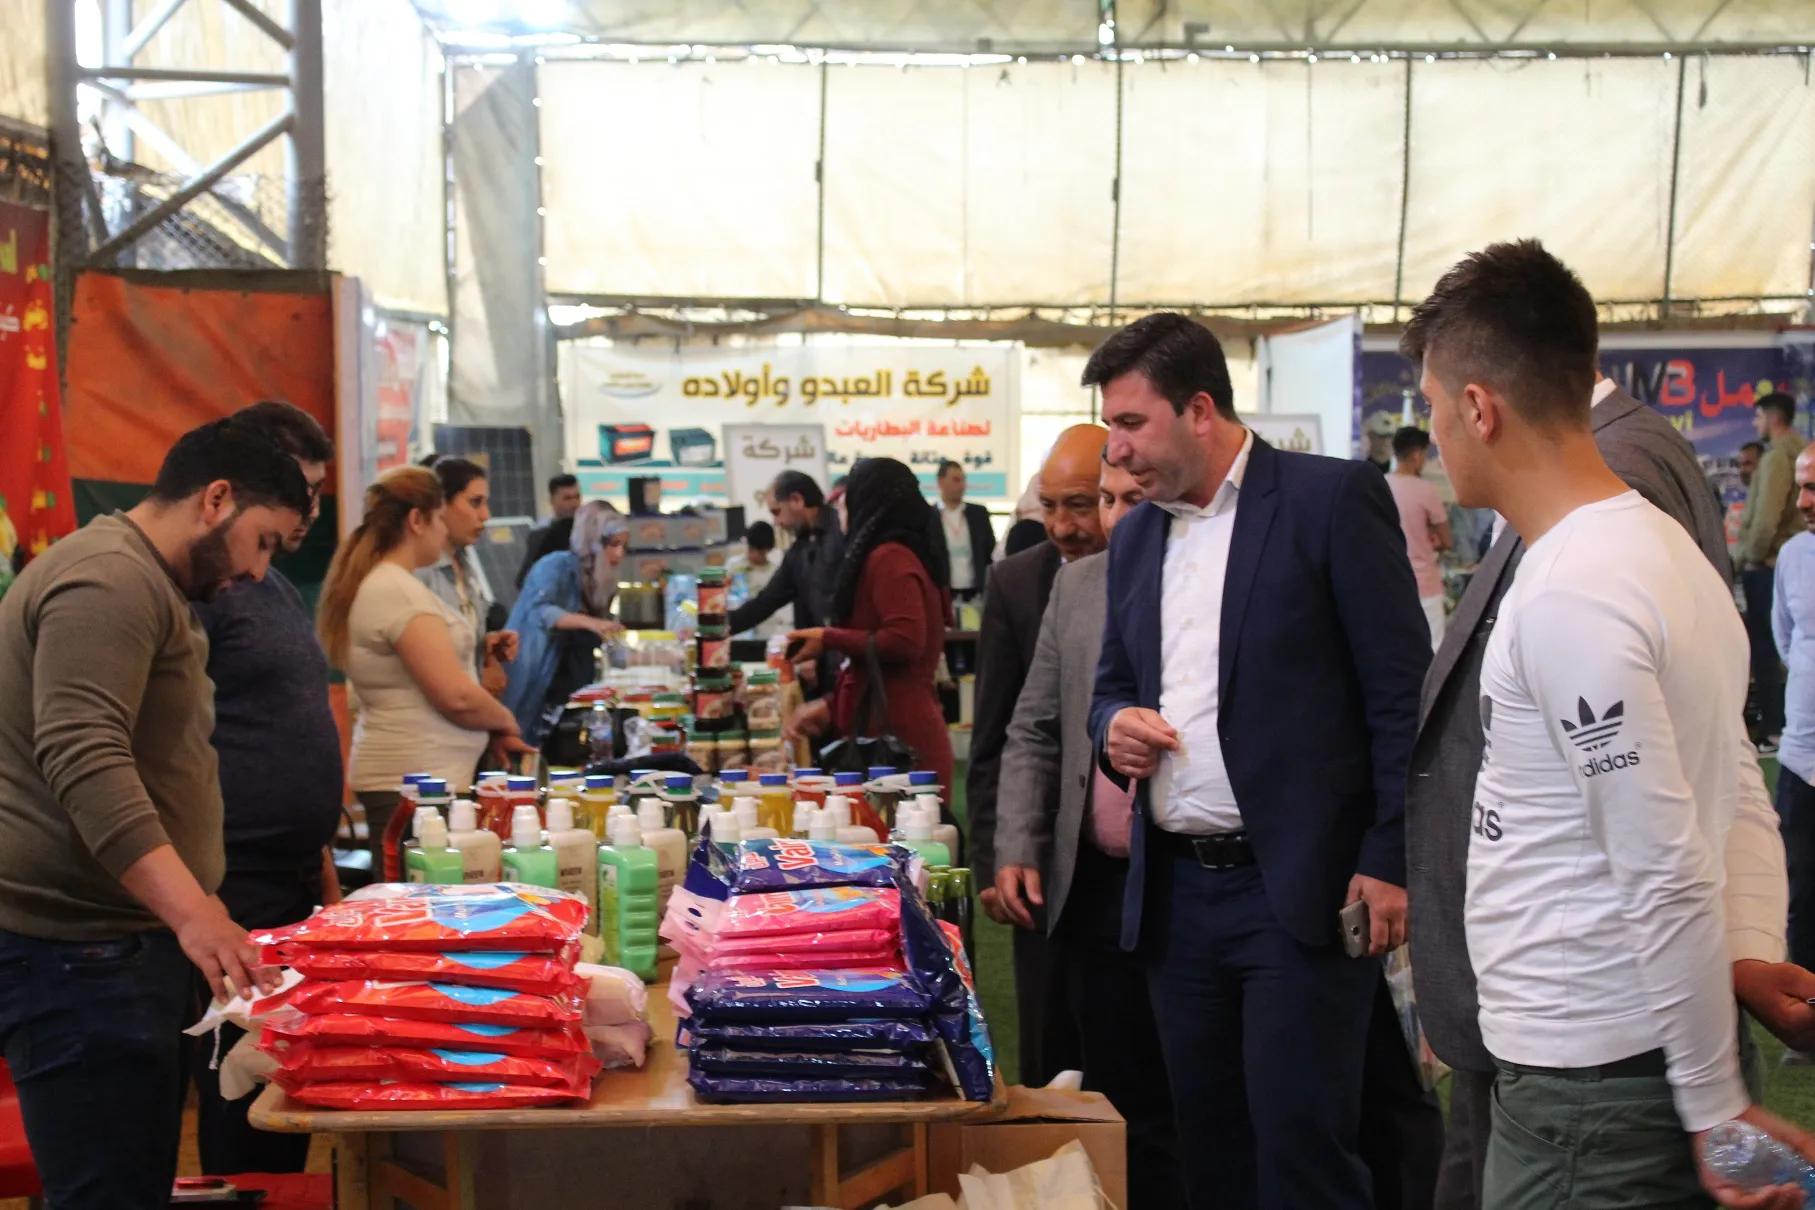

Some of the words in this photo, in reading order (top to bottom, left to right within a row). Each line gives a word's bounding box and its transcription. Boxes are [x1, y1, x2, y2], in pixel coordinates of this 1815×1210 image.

[682, 361, 790, 407] وأولاده
[799, 368, 893, 406] العبدو
[903, 364, 991, 407] شركة
[834, 419, 921, 442] البطاريات
[926, 419, 991, 437] لصناعة
[742, 433, 816, 464] شركة
[1578, 751, 1640, 778] didas
